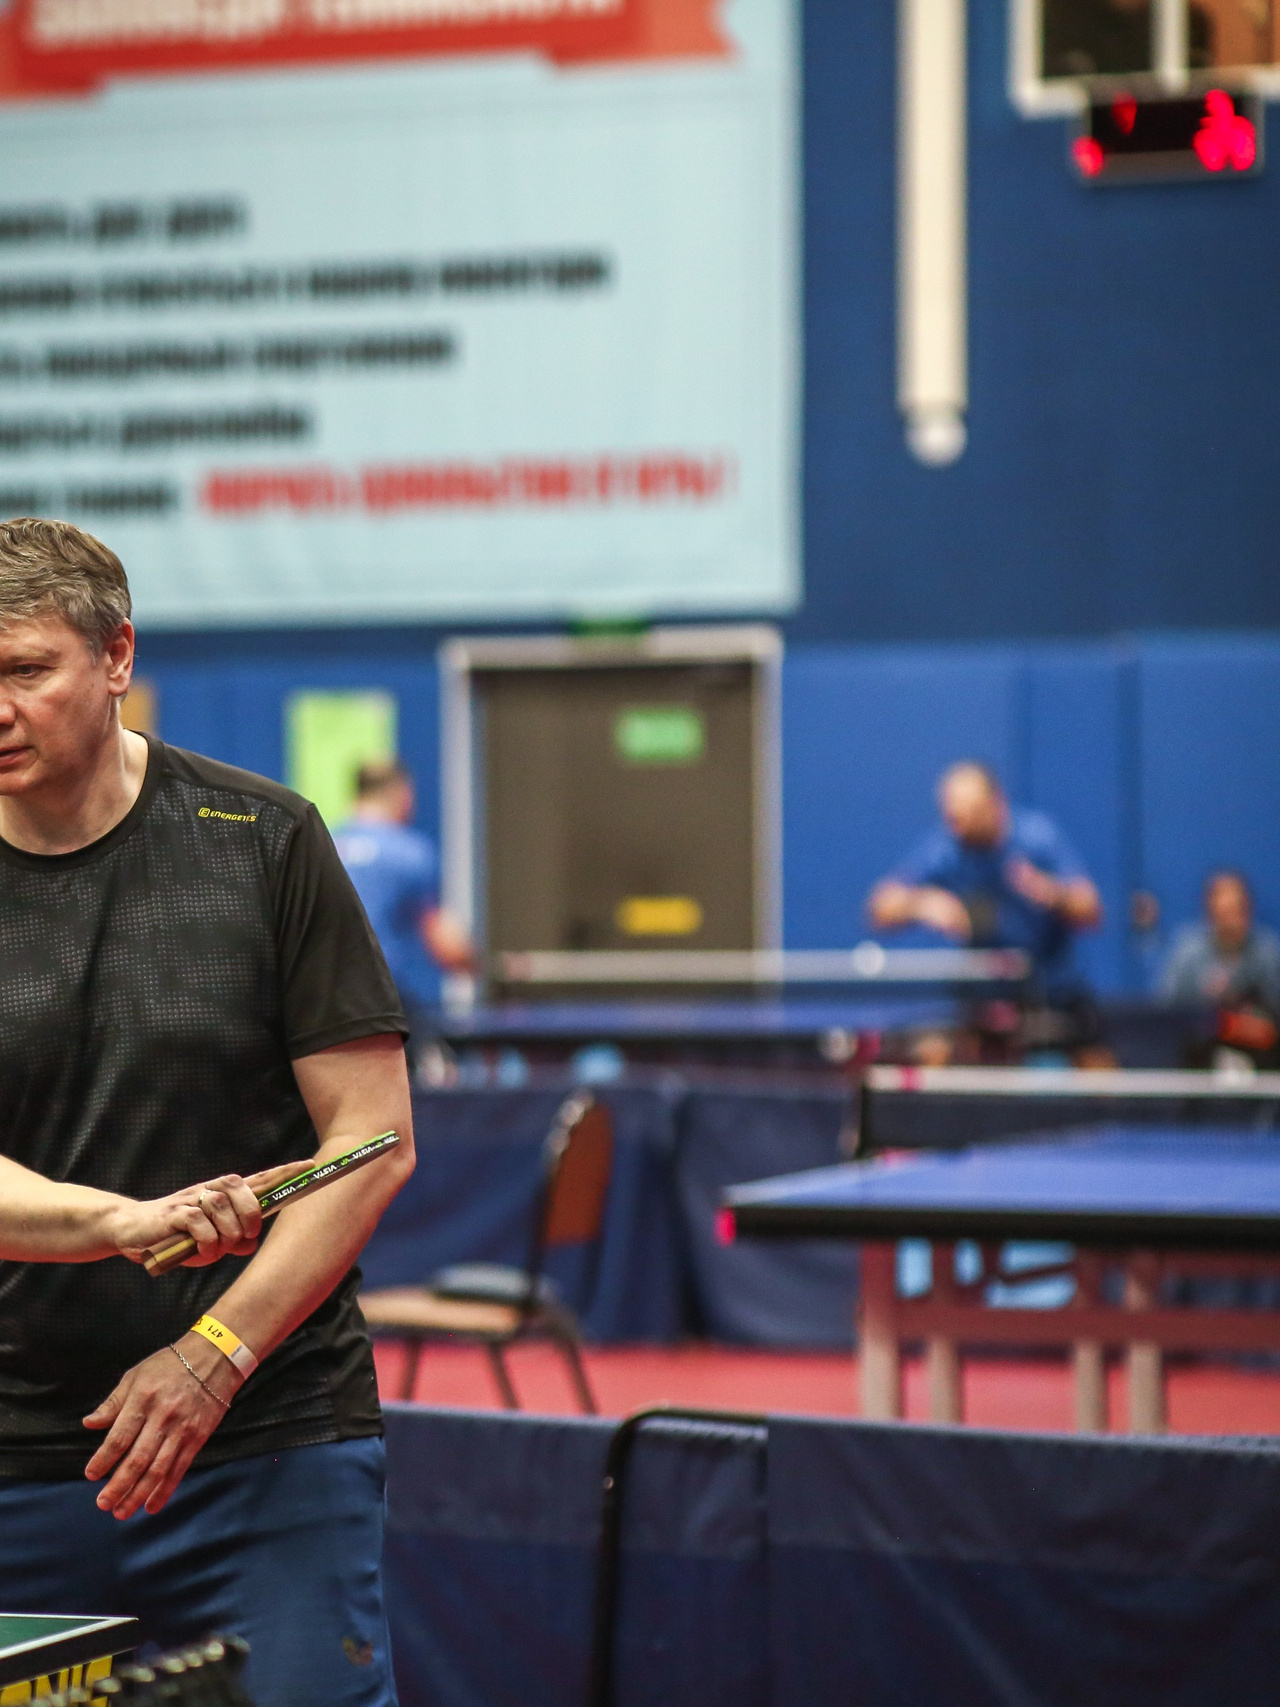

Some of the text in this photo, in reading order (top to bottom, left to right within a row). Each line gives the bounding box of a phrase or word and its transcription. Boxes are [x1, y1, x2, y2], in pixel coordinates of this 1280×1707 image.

[313, 1164, 337, 1179] VISTA
[272, 1186, 296, 1201] VISTA
[207, 1324, 224, 1338] 471
